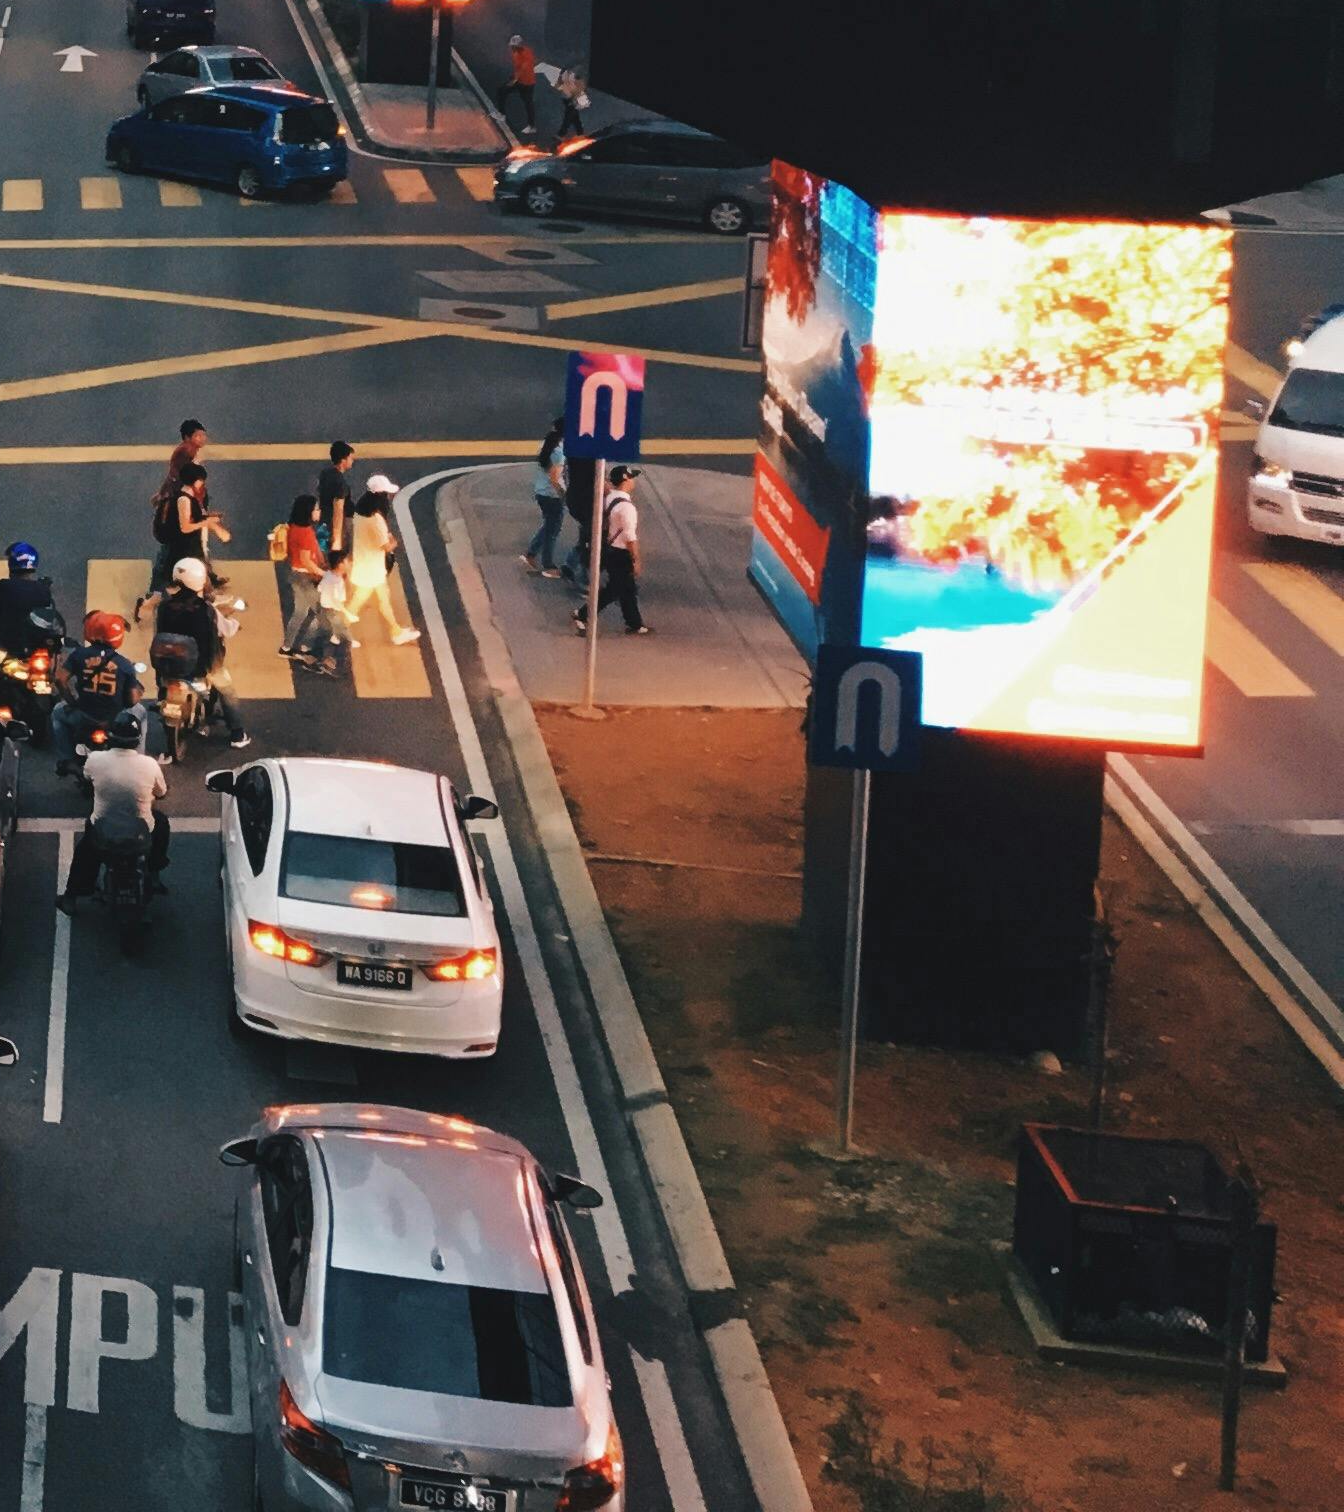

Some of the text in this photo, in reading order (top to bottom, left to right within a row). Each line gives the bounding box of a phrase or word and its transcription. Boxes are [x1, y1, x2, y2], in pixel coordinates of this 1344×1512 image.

[344, 965, 361, 980] WA
[364, 968, 394, 983] 9166
[414, 1484, 447, 1505] VCG
